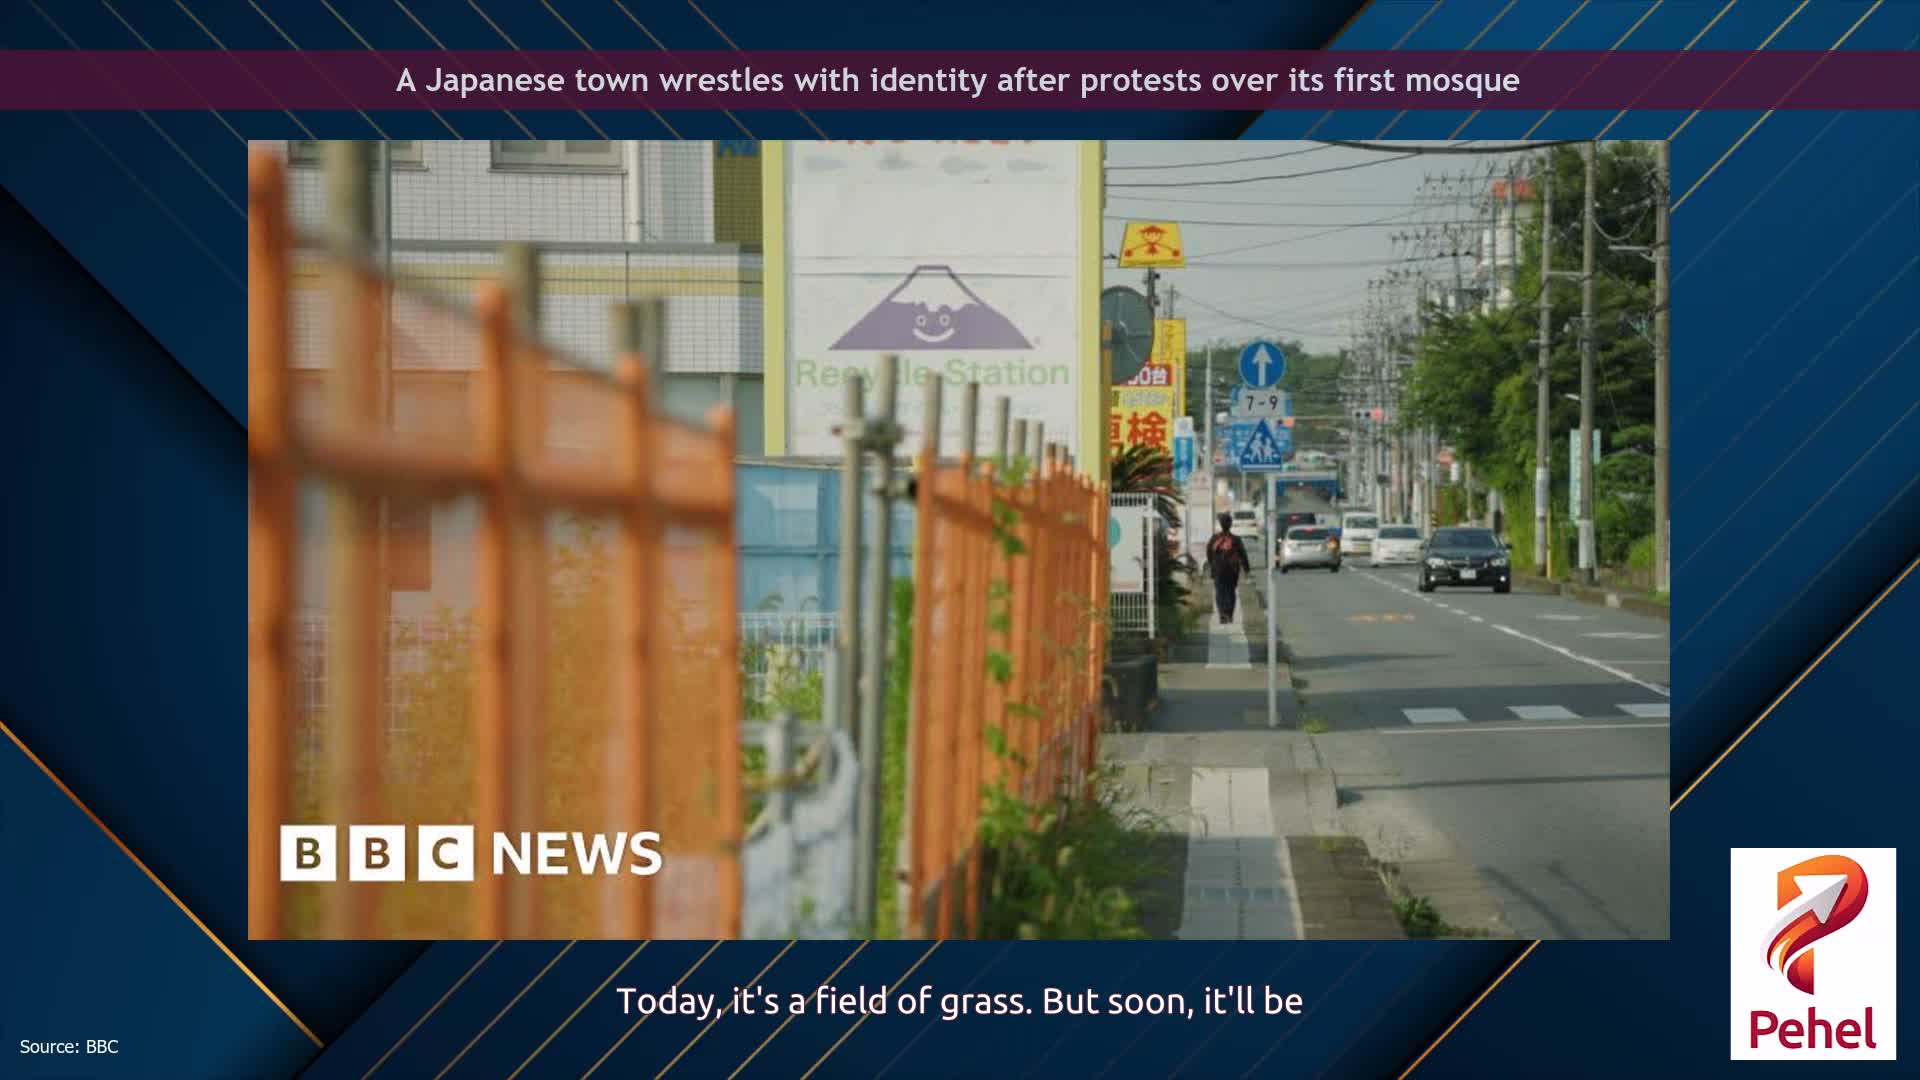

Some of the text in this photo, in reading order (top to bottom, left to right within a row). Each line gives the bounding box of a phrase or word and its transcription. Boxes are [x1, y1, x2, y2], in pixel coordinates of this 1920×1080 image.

[795, 358, 1070, 393] Recyle Station
[1245, 395, 1279, 411] 7-9
